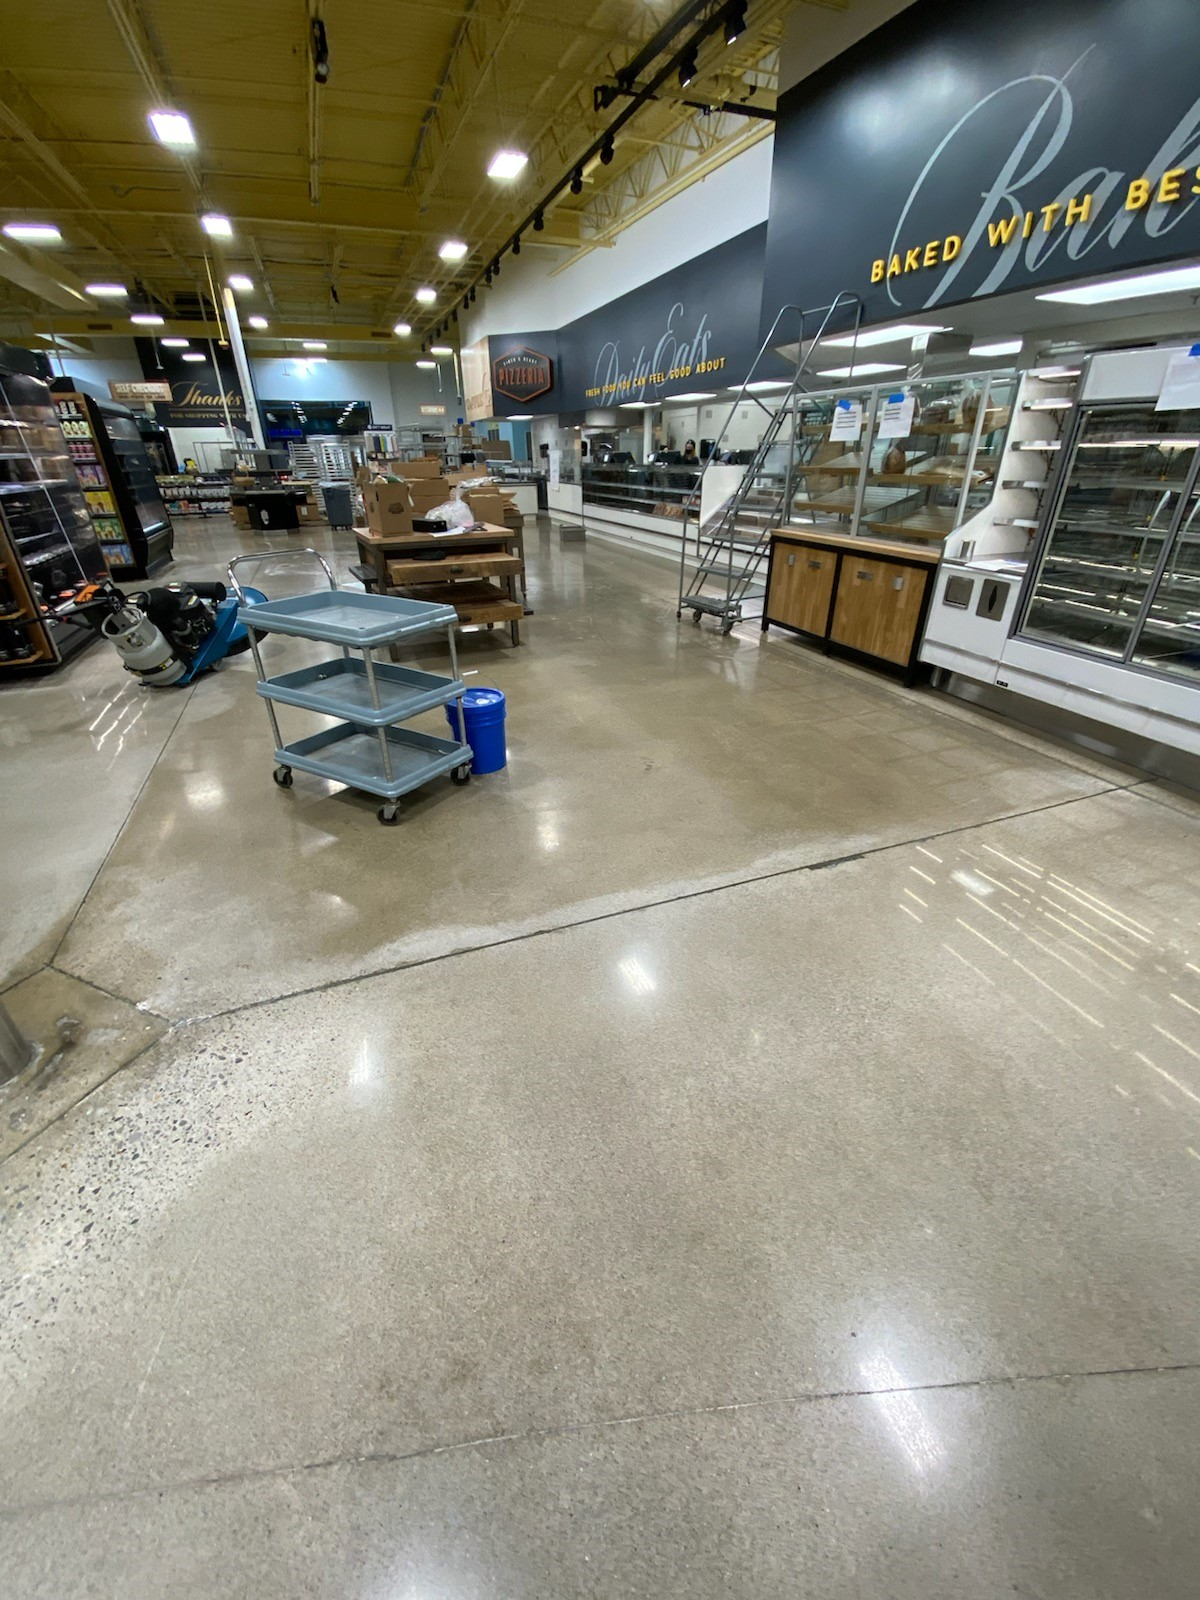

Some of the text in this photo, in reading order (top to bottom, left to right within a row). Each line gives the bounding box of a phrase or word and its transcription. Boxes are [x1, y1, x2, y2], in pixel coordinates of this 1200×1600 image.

[870, 234, 962, 284] BAKED
[988, 193, 1093, 248] WITH
[115, 383, 165, 395] SELF CHECKOUT
[498, 367, 545, 386] PIZZERIA
[585, 387, 601, 398] FRESH
[602, 383, 617, 394] FOOD
[634, 377, 647, 388] CAN
[649, 372, 666, 385] FEEL
[669, 365, 692, 380] GOOD
[695, 357, 726, 374] ABOUT
[171, 381, 243, 407] Thanks
